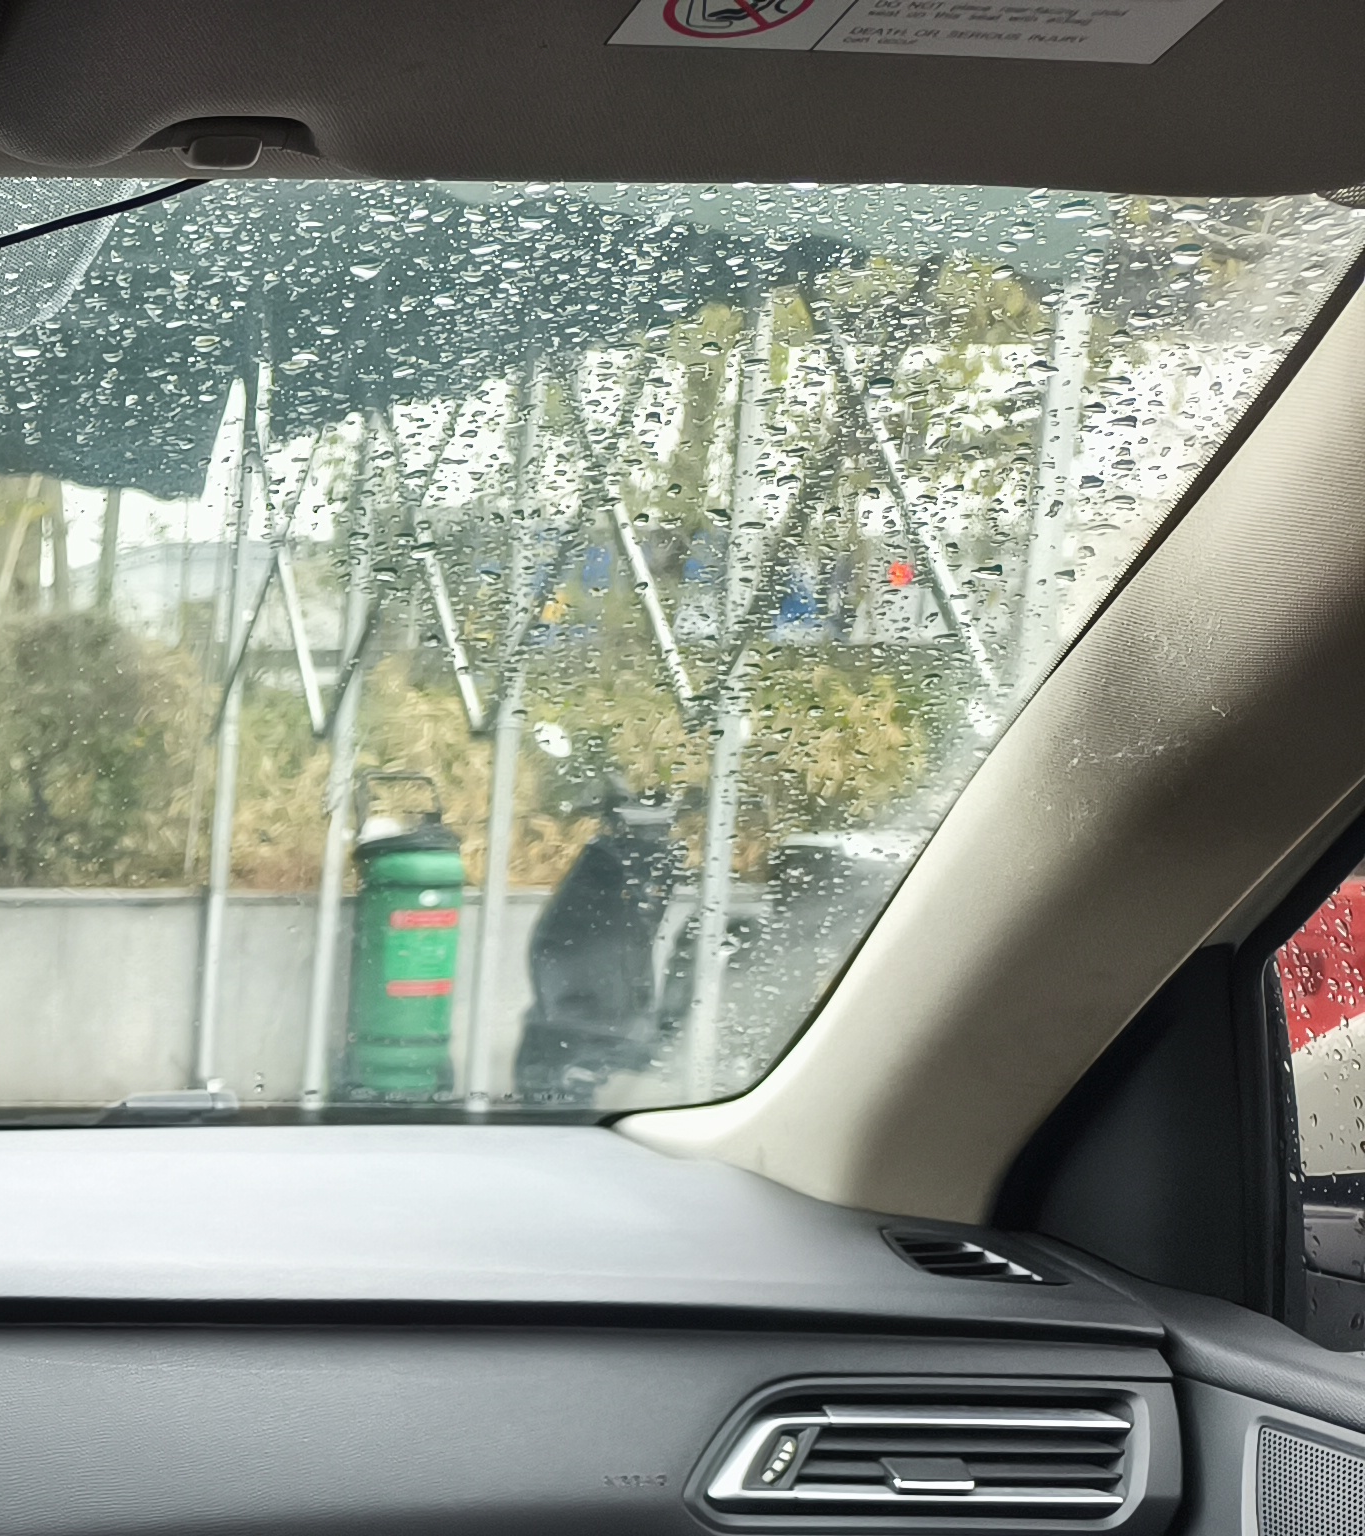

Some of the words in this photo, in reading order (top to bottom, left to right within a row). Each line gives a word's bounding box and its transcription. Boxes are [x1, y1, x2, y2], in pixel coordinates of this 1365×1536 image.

[849, 26, 908, 37] DEATH
[914, 29, 941, 38] OR
[947, 30, 1022, 41] SERIOUS
